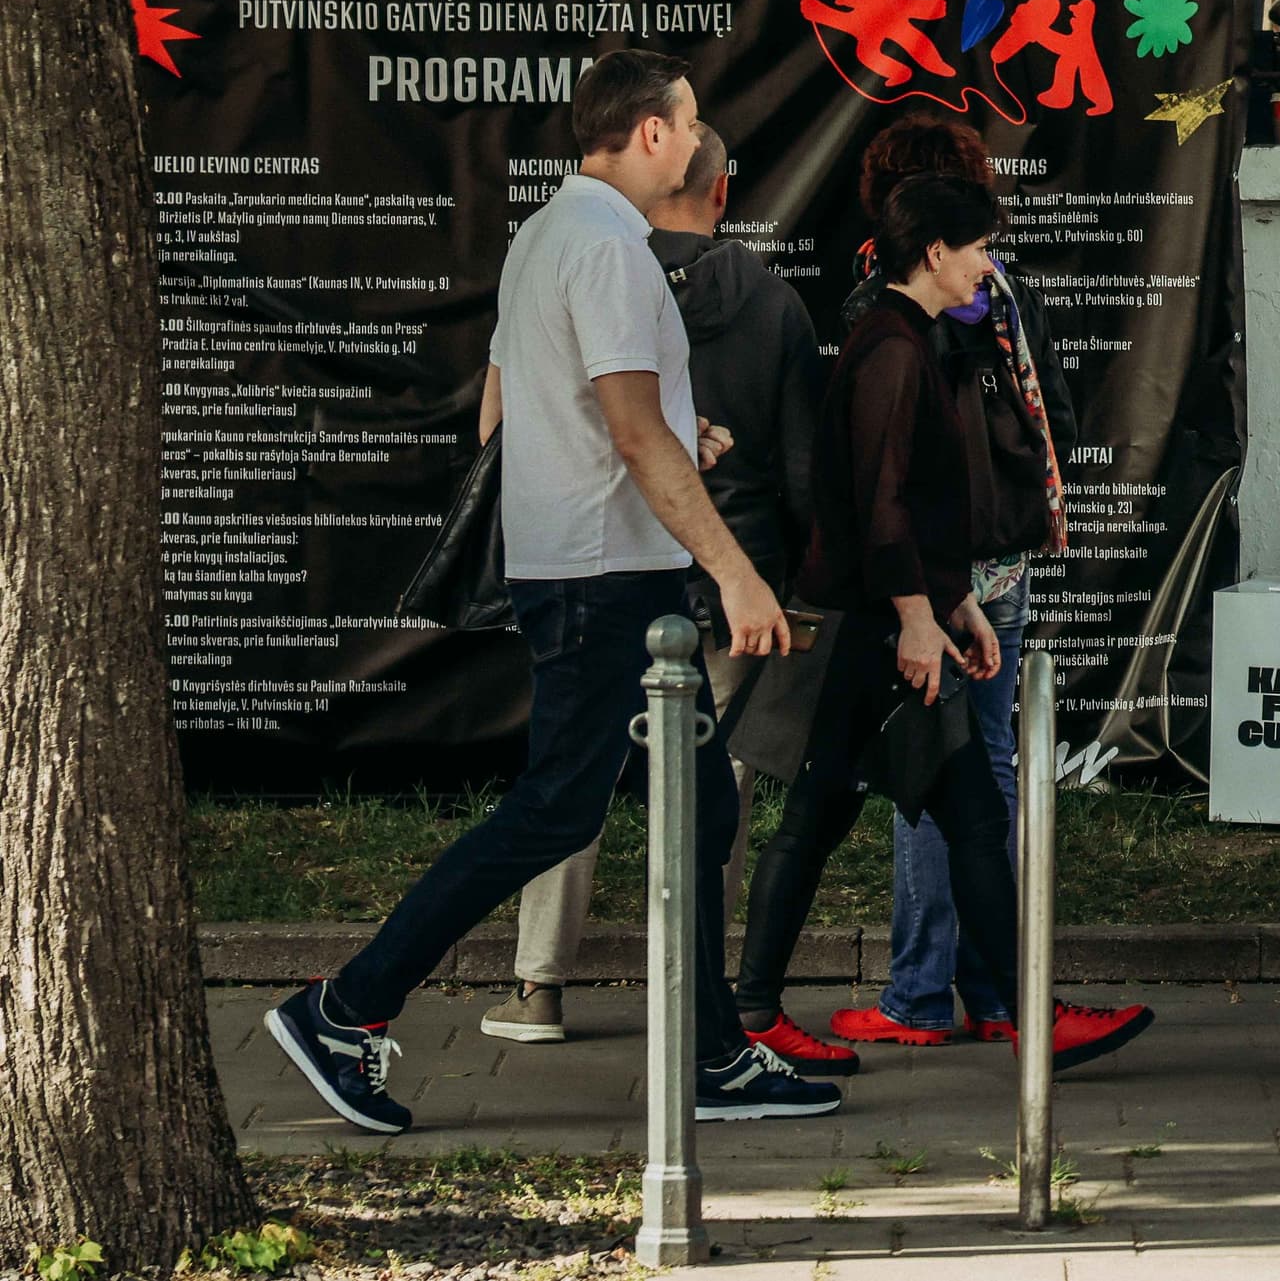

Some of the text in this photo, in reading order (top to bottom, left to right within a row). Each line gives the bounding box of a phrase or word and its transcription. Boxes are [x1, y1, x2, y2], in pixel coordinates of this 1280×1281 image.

[239, 0, 378, 30] PUTVINSKIO
[479, 2, 548, 32] DIENA
[656, 3, 732, 38] GATVĘ!
[154, 155, 320, 175] UELIO LEVINO CENTRAS
[508, 159, 581, 177] NACIONAL
[185, 191, 227, 205] Paskaita
[287, 193, 333, 206] medicina
[374, 193, 415, 209] paskaitą
[508, 181, 558, 203] DAILĖS
[1065, 191, 1112, 207] Dominyko
[1113, 191, 1194, 206] Andriuškevičiaus
[159, 210, 427, 228] Biržietis Mažylio gimdymo namų Dienos stacionaras,
[1038, 211, 1099, 225] mašinėlėmis
[1018, 229, 1115, 244] skvero, Putvinskio
[172, 248, 237, 264] nereikalinga.
[375, 276, 427, 290] Putvinskio
[1041, 274, 1145, 289] Instaliacija/dirbtuvės
[171, 292, 208, 306] trukmė:
[186, 316, 251, 334] Šilkografinės
[253, 321, 293, 335] spaudos
[294, 321, 342, 335] dirbtuvės
[162, 337, 390, 355] Pradžia Levino centro kiemelyje, Putvinskio
[1062, 335, 1133, 351] Greta Štiormer
[173, 356, 235, 372] nereikalinga
[183, 383, 230, 399] Knygynas
[281, 384, 317, 398] kviečia
[318, 385, 372, 401] susipažinti
[202, 403, 223, 417] prie
[214, 429, 457, 446] Kauno rekonstrukcija Sandros Bernotaitės romane
[203, 447, 390, 464] pokalbis rašytoja Sandra Bernotaite
[1067, 447, 1114, 465] AIPTAI
[1083, 482, 1167, 498] vardo bibliotekoje
[182, 512, 442, 529] Kauno apskrities viešosios bibliotekos kūrybinė erdvė
[193, 550, 288, 566] knygų instaliacijos.
[1063, 545, 1148, 561] Dovile Lapinskaite
[194, 569, 308, 585] šiandien kalba knygos?
[1062, 589, 1151, 606] Strategijos miestui
[191, 614, 238, 628] Patirtinis
[240, 615, 328, 630] pasivaikščiojimas
[1039, 609, 1073, 623] vidinis
[167, 633, 242, 647] Levino skveras,
[1048, 635, 1106, 652] pristatymas
[1054, 653, 1109, 667] Pliuščikaitė
[182, 679, 407, 694] Knygrišystės dirbtuvės Paulina Ružauskaite
